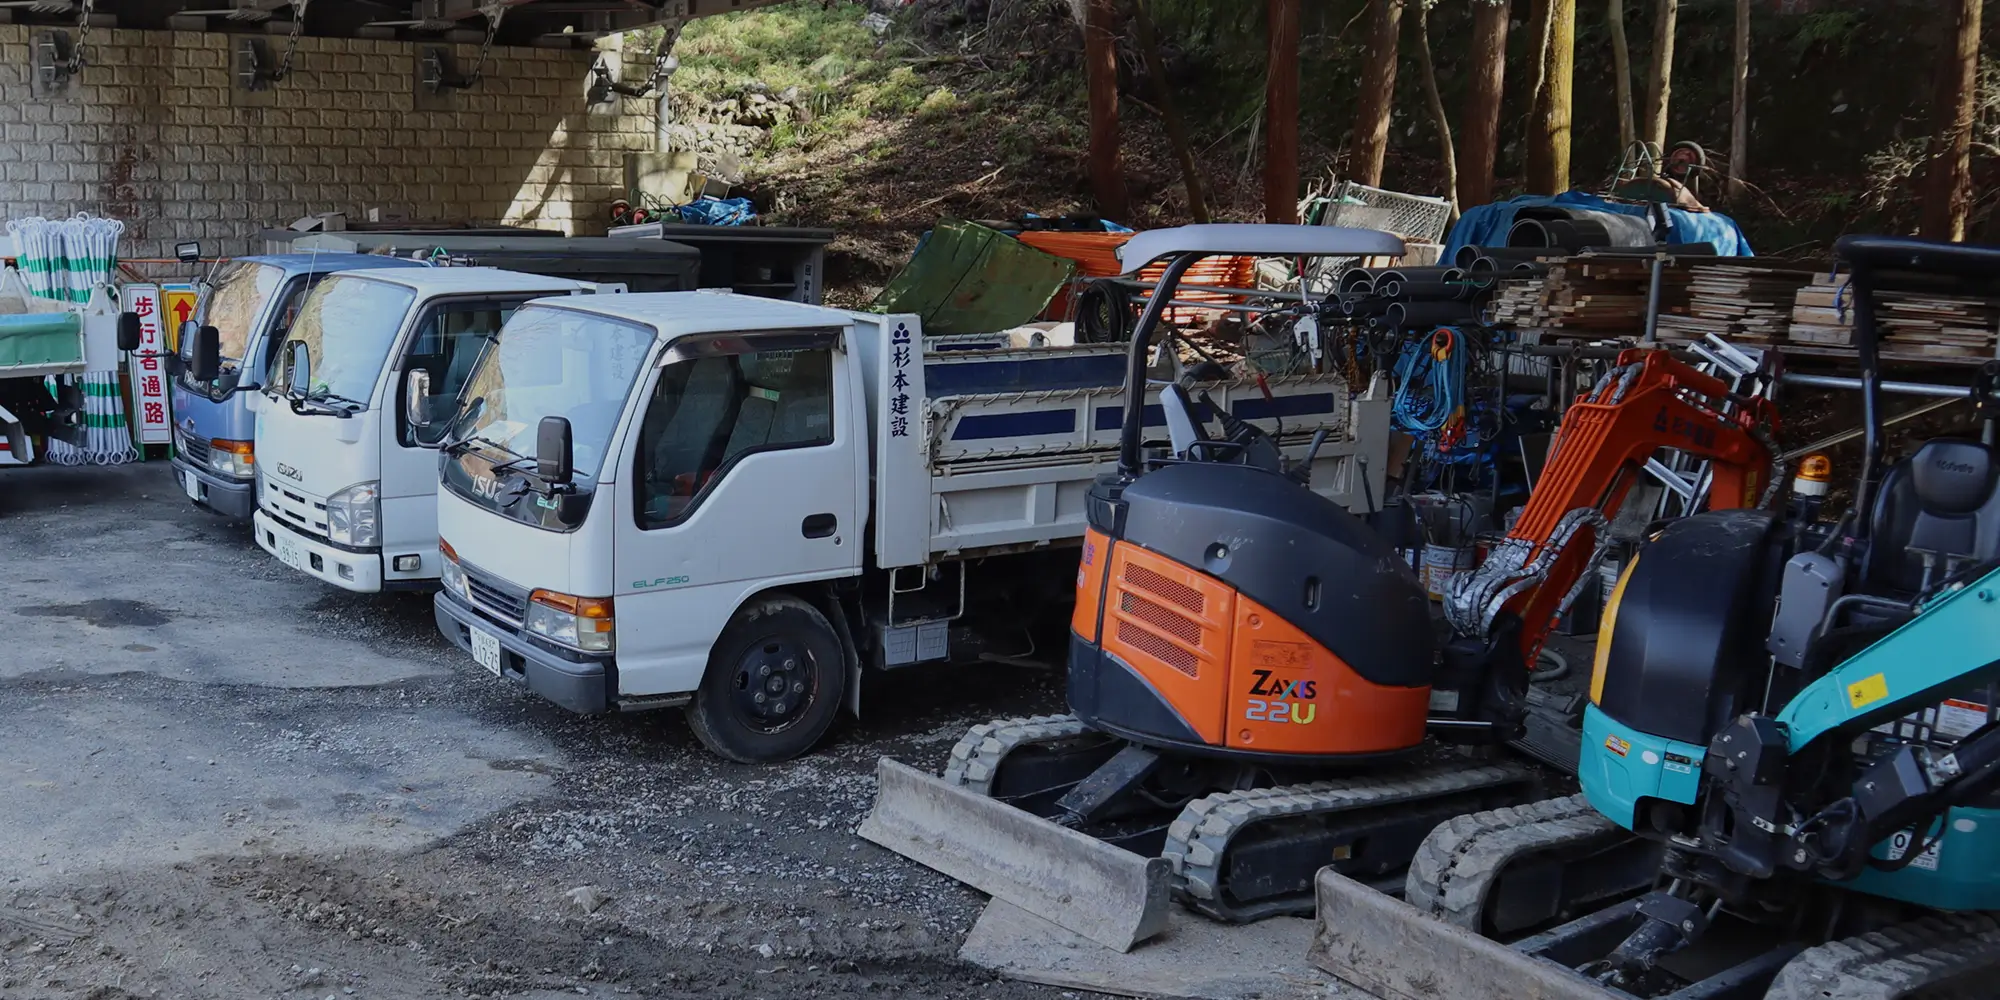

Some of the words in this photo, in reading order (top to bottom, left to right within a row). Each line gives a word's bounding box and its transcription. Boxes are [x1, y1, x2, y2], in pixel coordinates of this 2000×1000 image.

[135, 295, 165, 425] 歩行者通路
[891, 345, 911, 438] 杉本建設
[276, 461, 303, 482] ISUZU
[1248, 668, 1317, 701] ZAXIS
[1245, 699, 1316, 725] 22U
